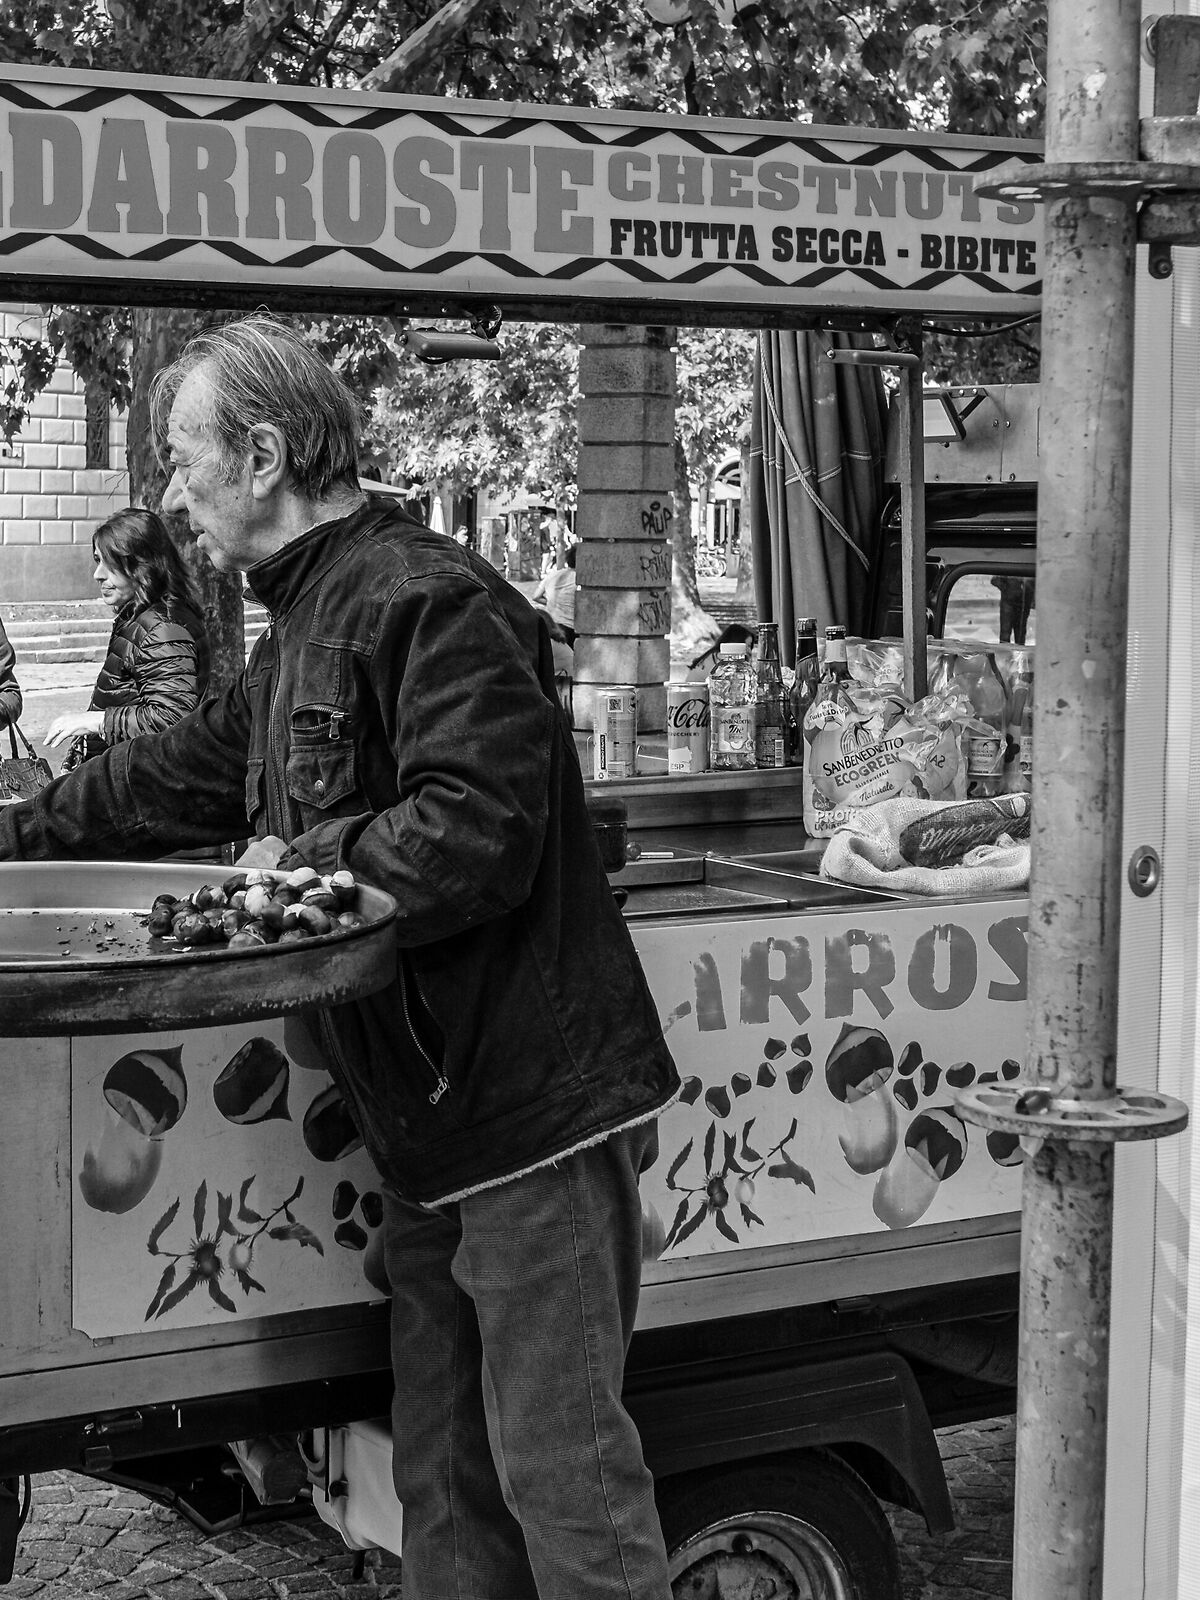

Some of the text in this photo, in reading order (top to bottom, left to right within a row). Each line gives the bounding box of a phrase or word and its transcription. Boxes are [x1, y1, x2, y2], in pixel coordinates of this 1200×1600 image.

[609, 218, 759, 261] FRUTTA
[773, 225, 886, 267] SECCA
[921, 233, 1037, 275] BIBITE
[834, 752, 902, 787] ECOGREEN
[859, 781, 895, 802] Naturale
